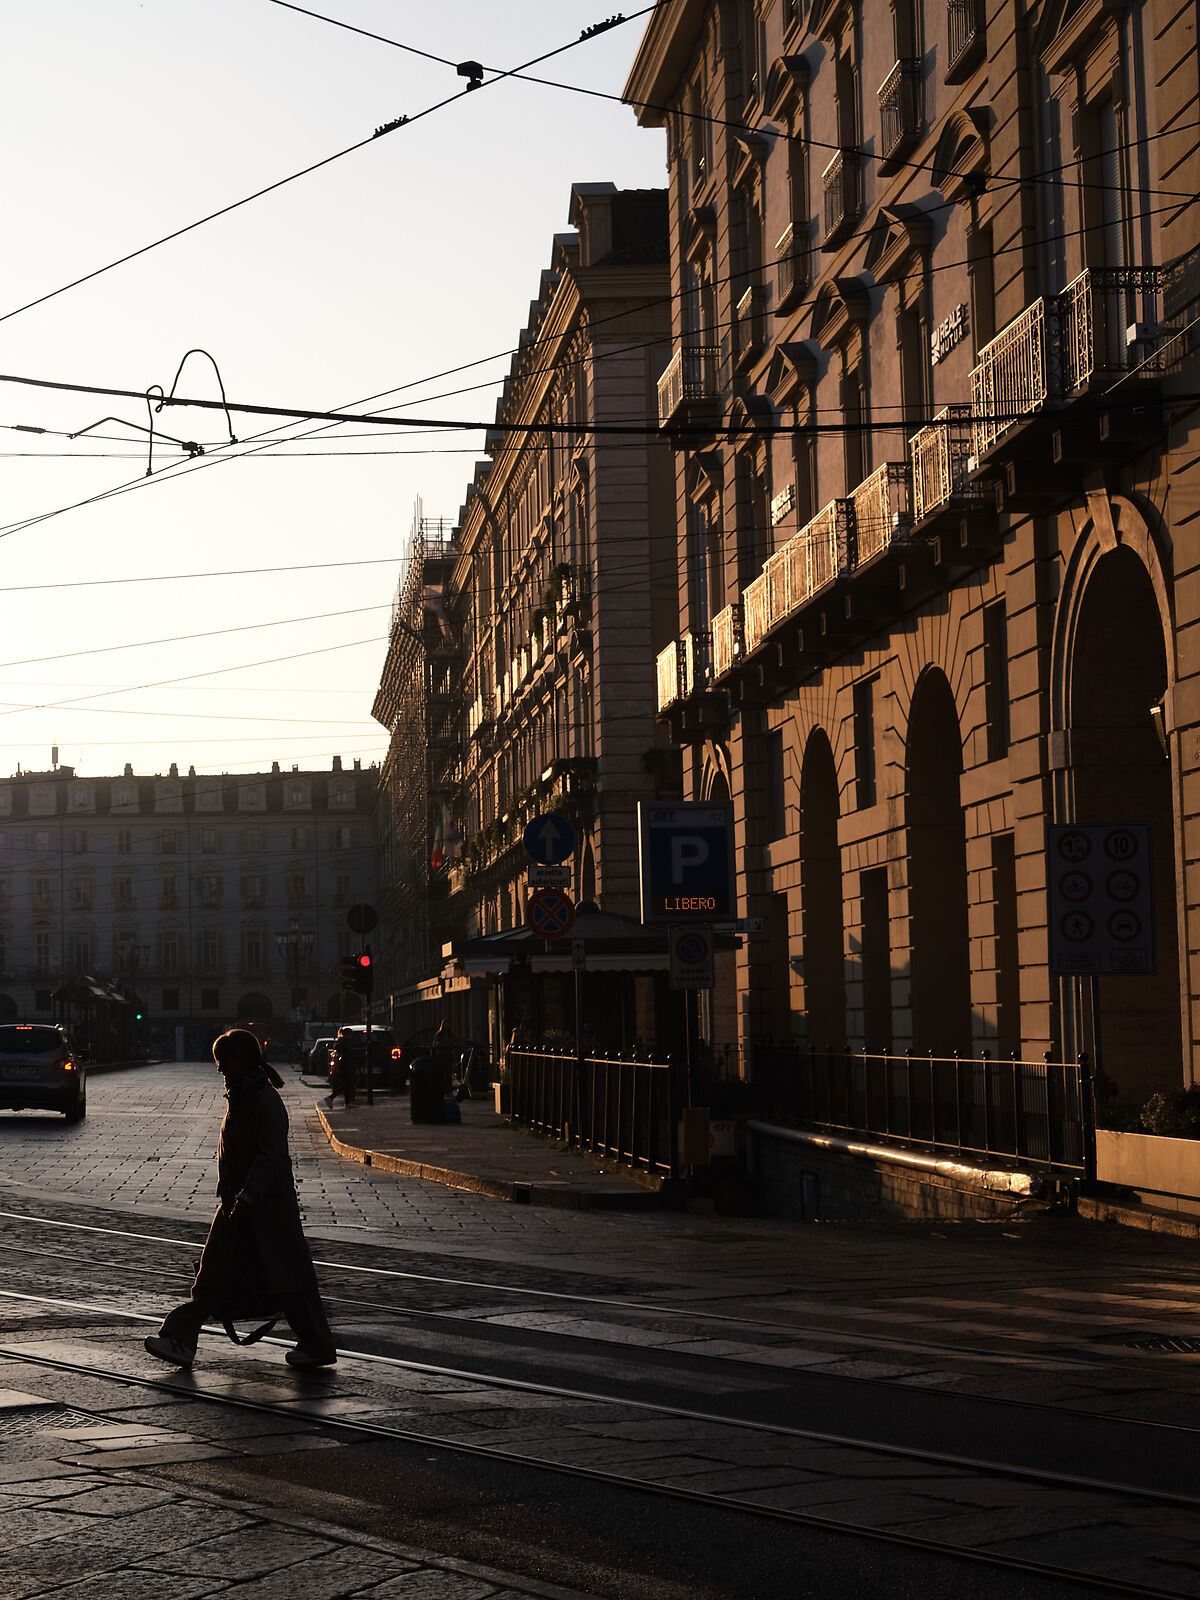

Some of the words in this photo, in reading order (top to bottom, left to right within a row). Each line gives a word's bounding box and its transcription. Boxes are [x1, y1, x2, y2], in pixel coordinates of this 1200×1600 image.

[939, 304, 963, 342] REALE
[940, 324, 964, 357] MUTUA
[671, 835, 710, 885] P
[1114, 836, 1129, 854] 10
[664, 897, 716, 910] LIBERO
